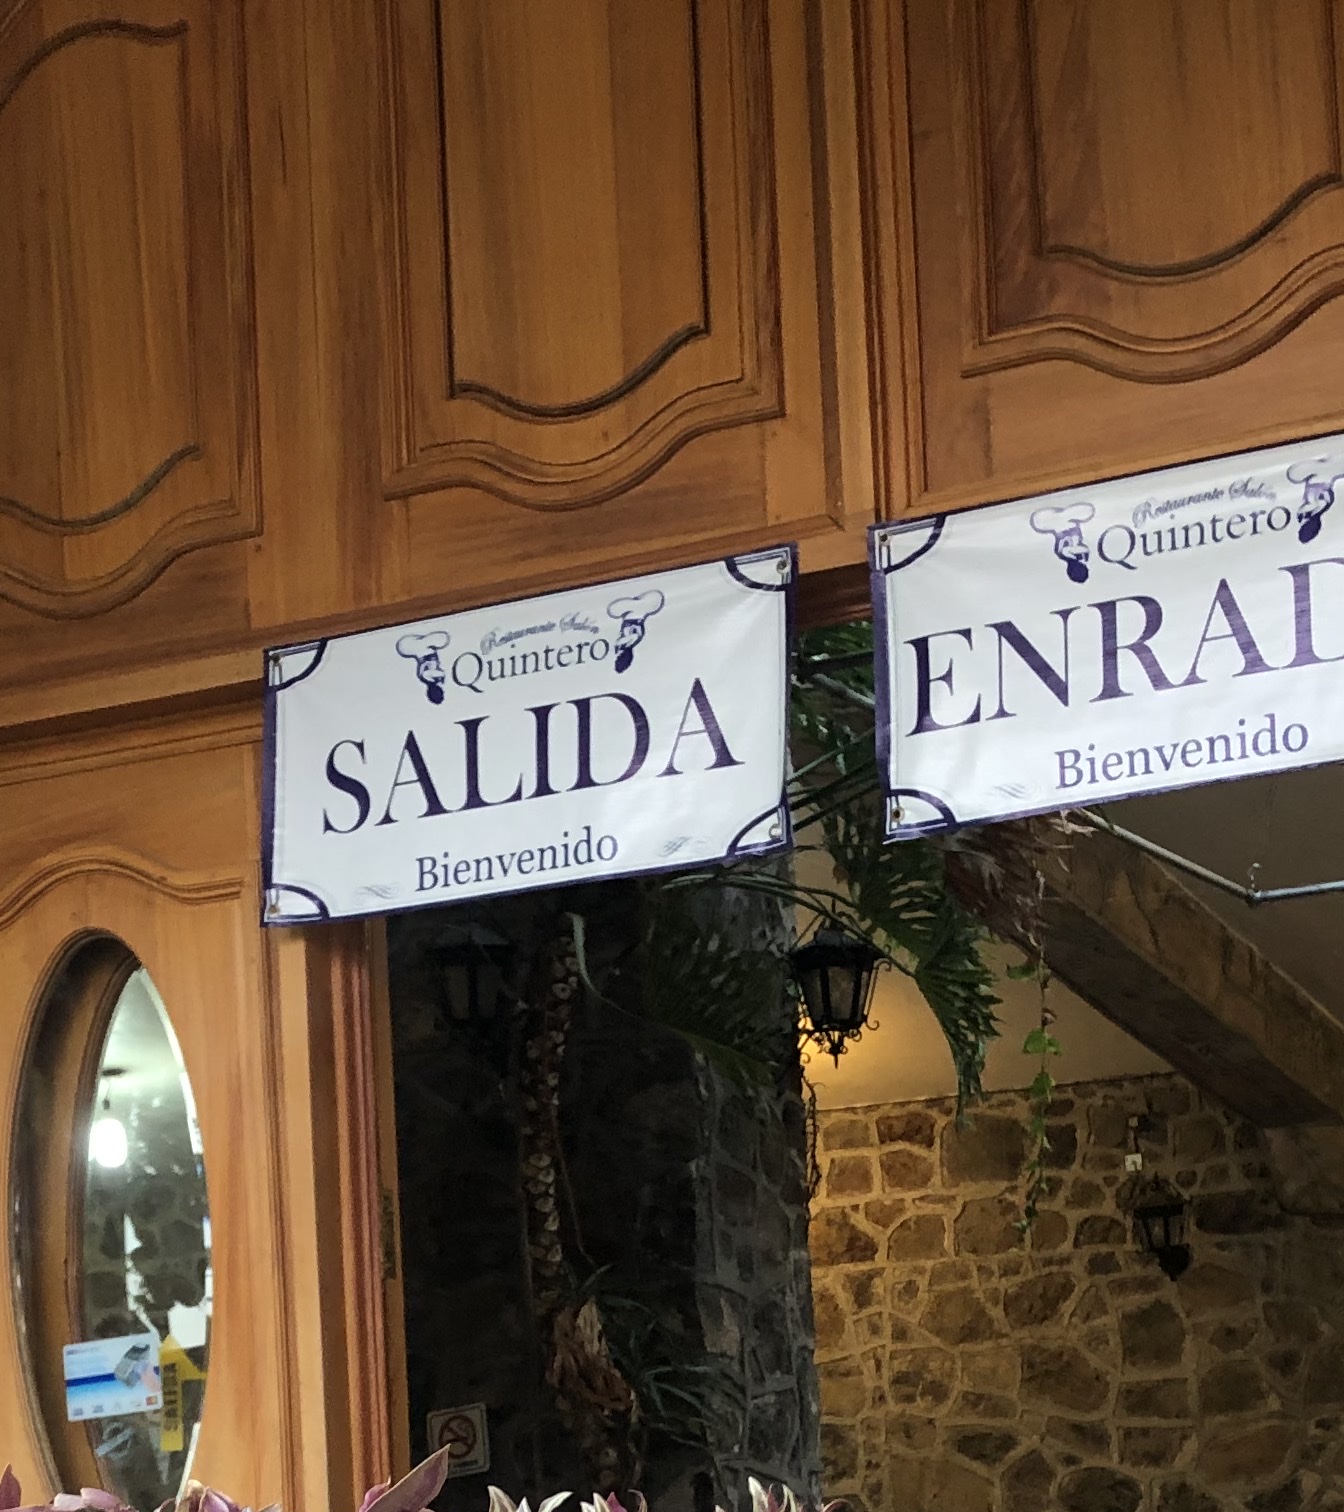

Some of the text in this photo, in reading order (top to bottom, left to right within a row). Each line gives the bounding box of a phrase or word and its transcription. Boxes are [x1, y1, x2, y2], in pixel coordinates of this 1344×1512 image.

[1097, 505, 1293, 570] Quintero
[451, 636, 610, 693] Quintero
[322, 677, 745, 835] SALIDA
[1055, 713, 1309, 789] Bienvenido
[416, 825, 619, 892] Bienvenido
